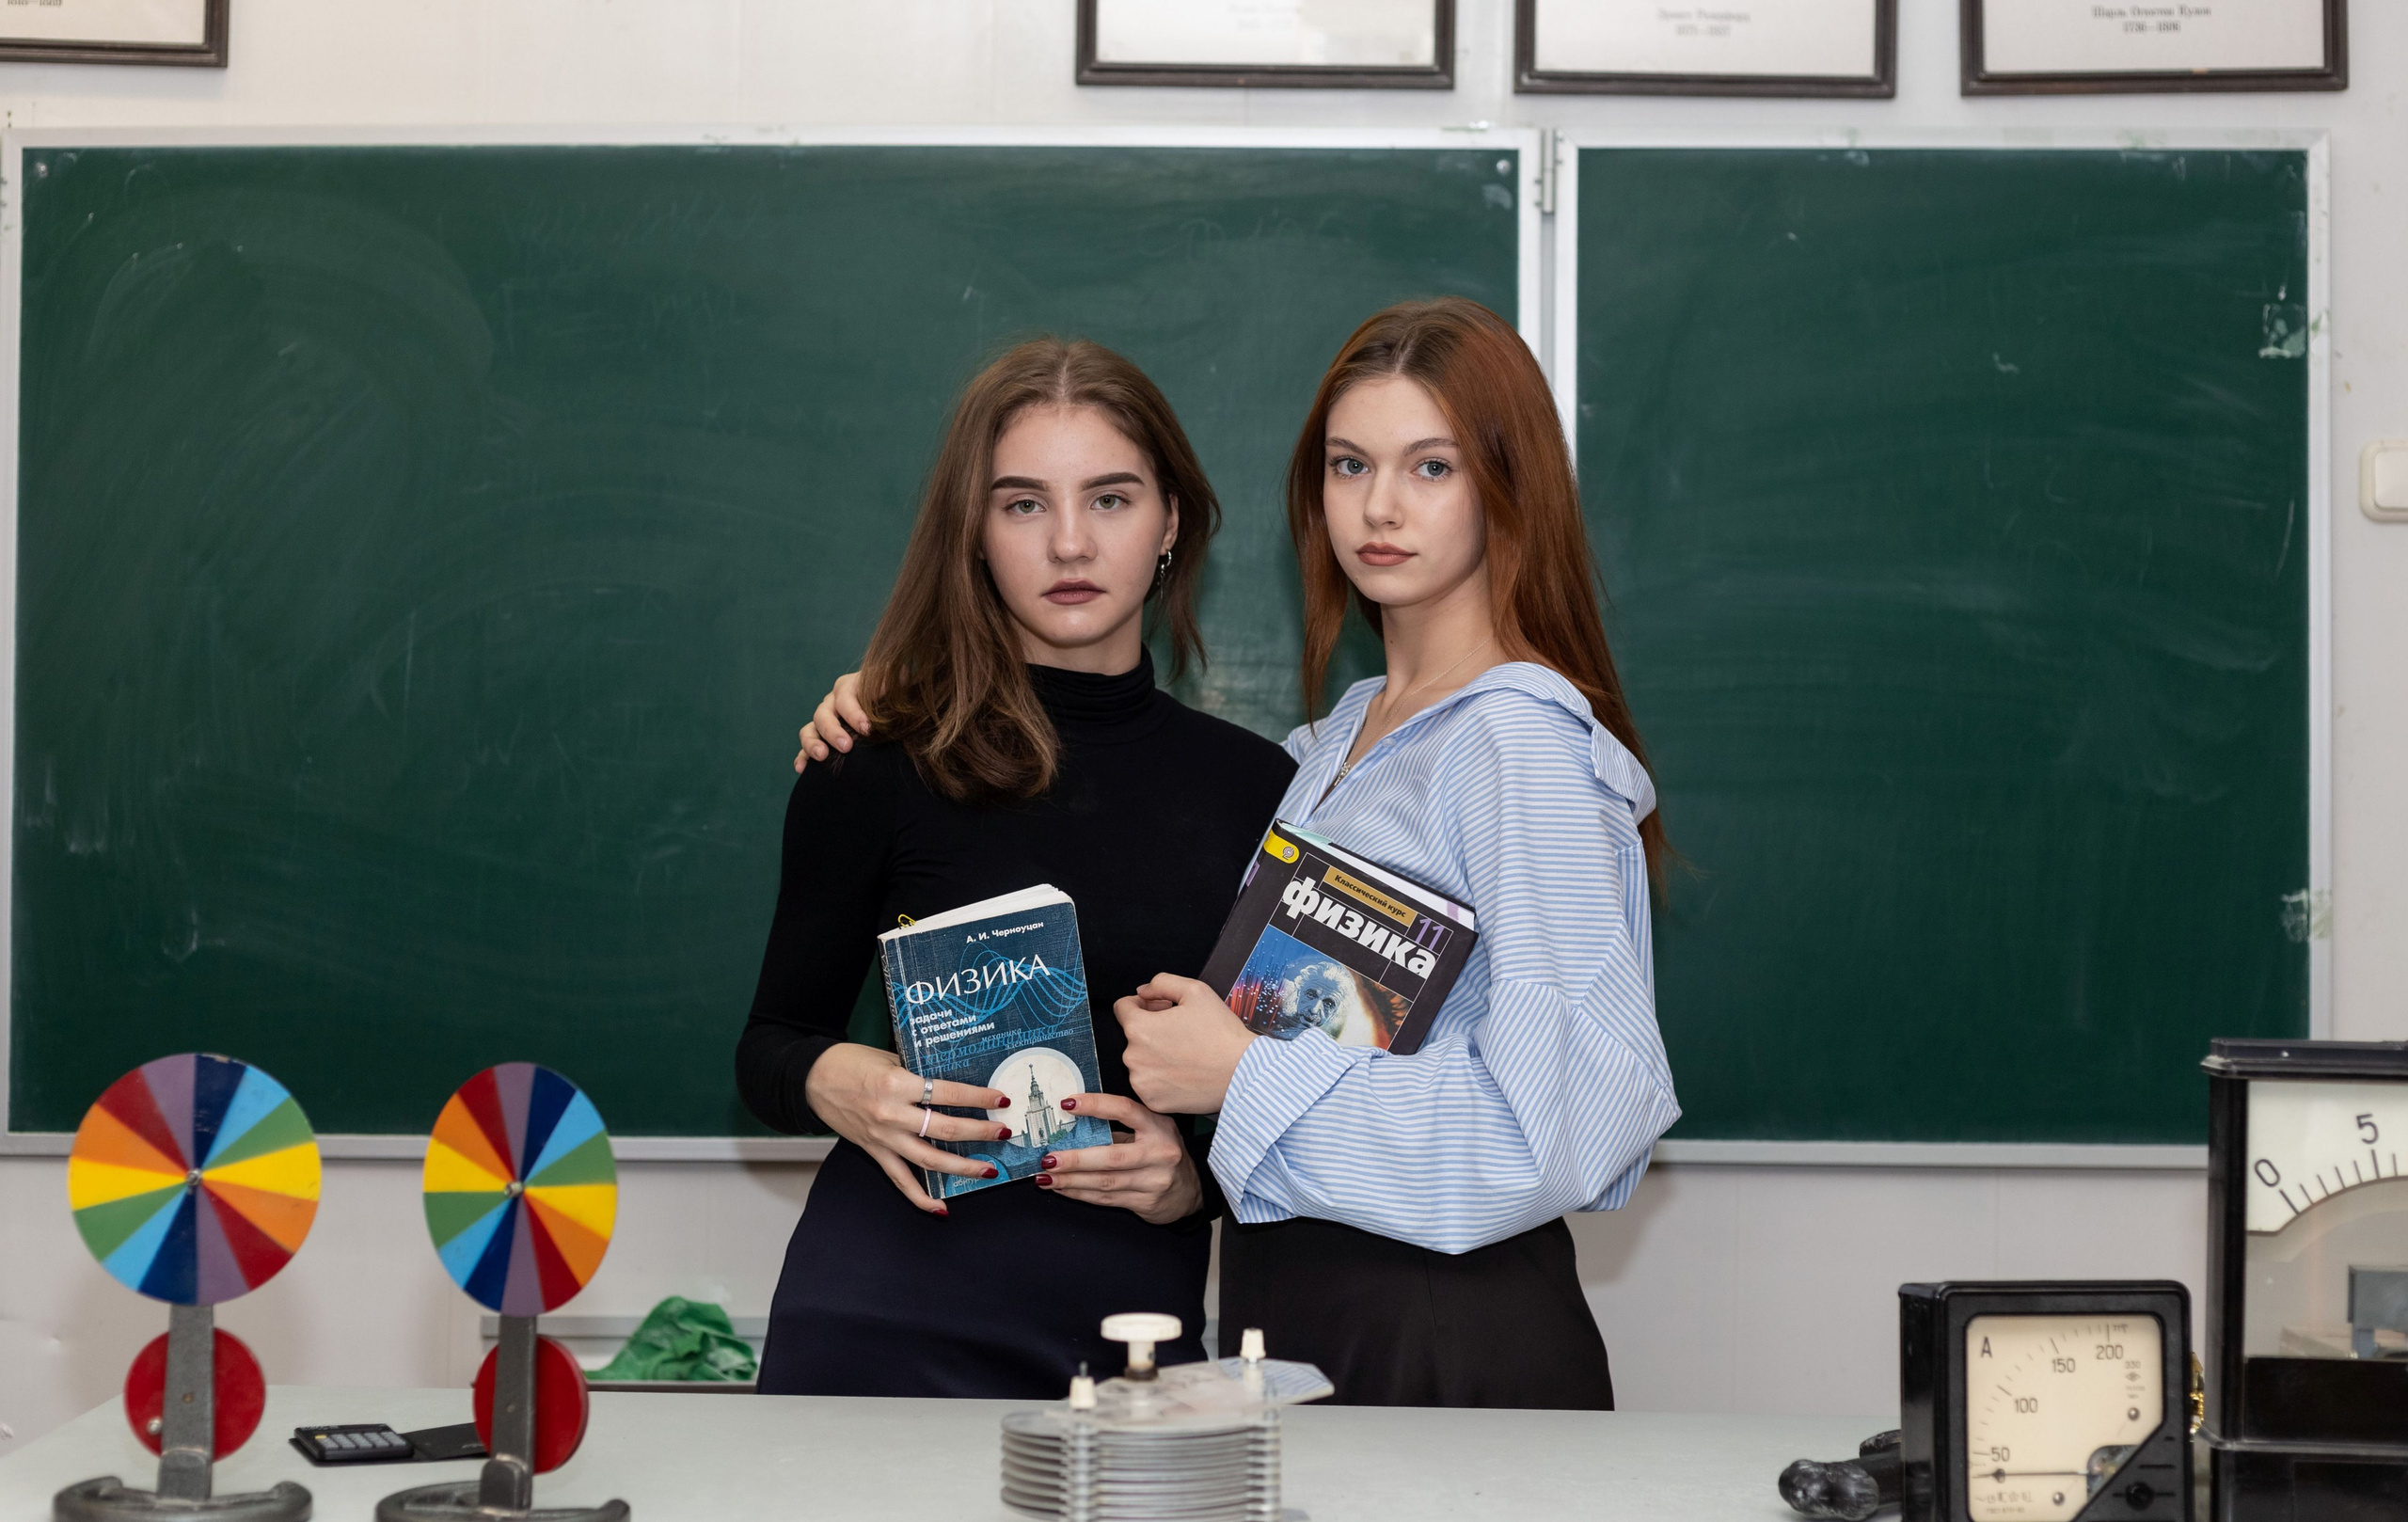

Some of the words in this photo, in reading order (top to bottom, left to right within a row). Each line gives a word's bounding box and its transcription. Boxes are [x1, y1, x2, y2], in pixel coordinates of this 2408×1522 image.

[1334, 874, 1387, 908] Классический
[1387, 904, 1406, 918] курс
[966, 935, 976, 943] А.
[978, 932, 990, 941] И.
[992, 921, 1044, 938] Черноуцан
[1281, 876, 1436, 980] физика
[1415, 917, 1445, 951] 11
[906, 954, 1052, 1005] ФИЗИКА
[921, 1014, 976, 1035] ответами
[925, 1022, 995, 1049] решениями
[2356, 1114, 2380, 1145] 5
[2254, 1158, 2281, 1189] 0
[2052, 1357, 2076, 1373] 150
[2096, 1344, 2124, 1360] 200
[2014, 1398, 2038, 1414] 100
[1990, 1447, 2011, 1463] 50
